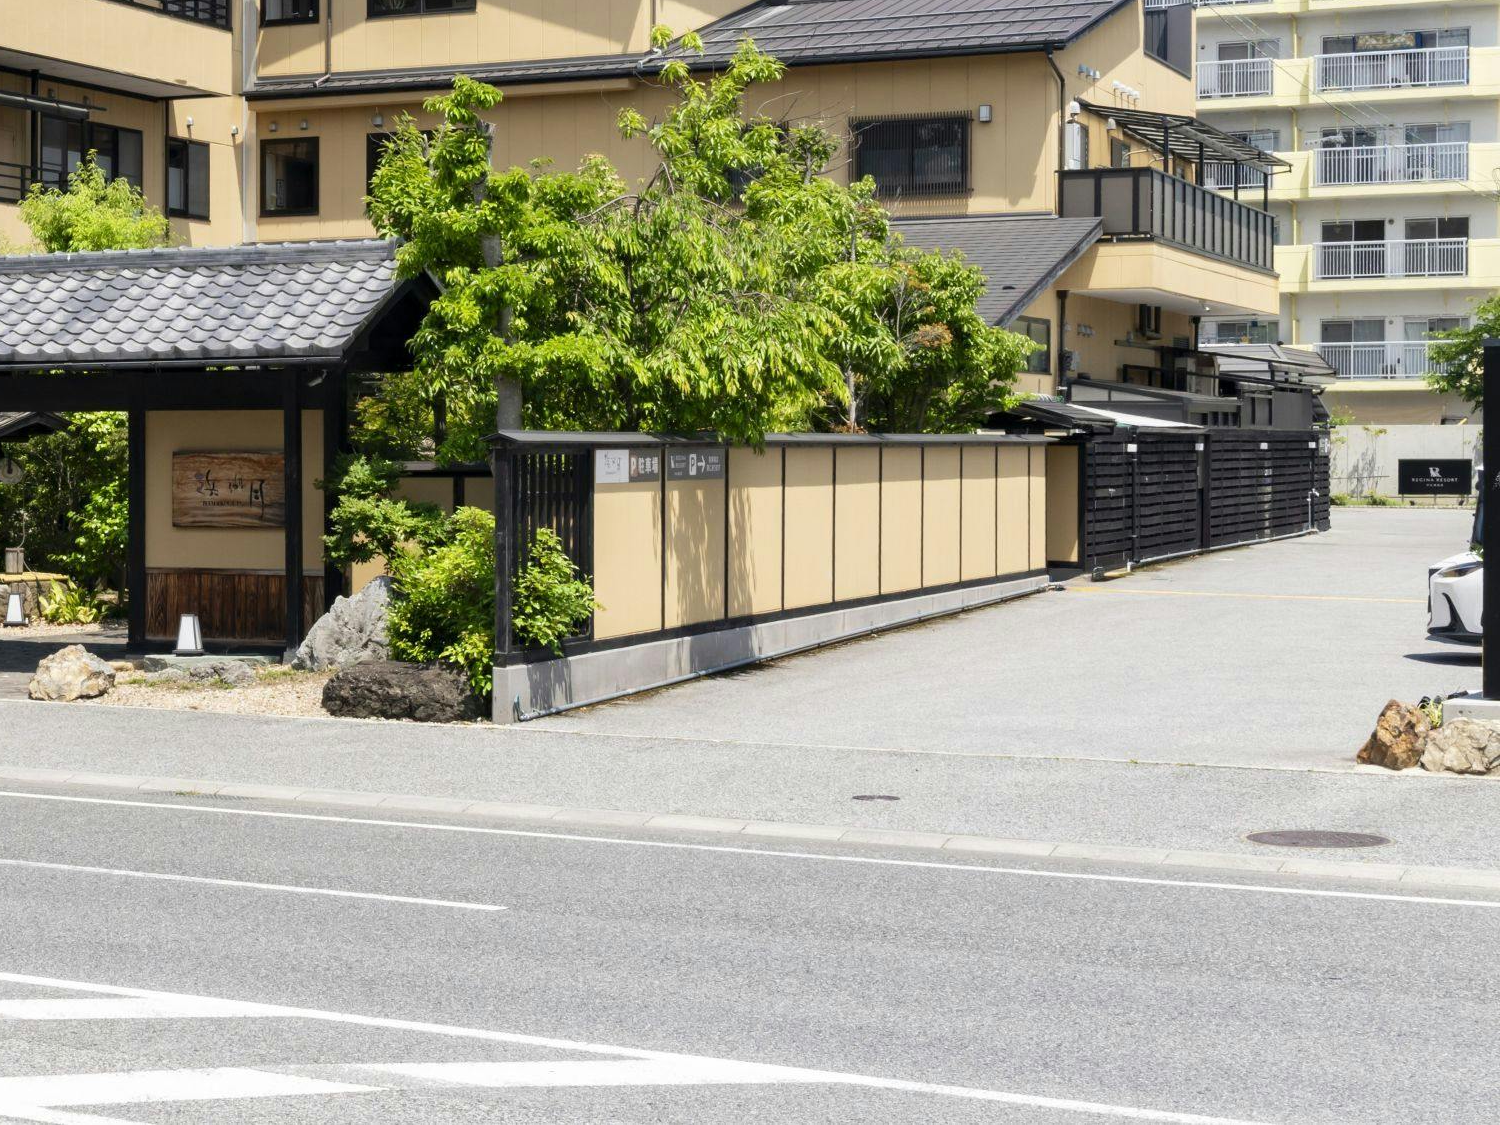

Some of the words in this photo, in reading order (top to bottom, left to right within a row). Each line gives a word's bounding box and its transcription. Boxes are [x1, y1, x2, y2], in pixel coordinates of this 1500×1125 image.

[631, 457, 637, 475] P
[638, 456, 659, 474] 駐車場
